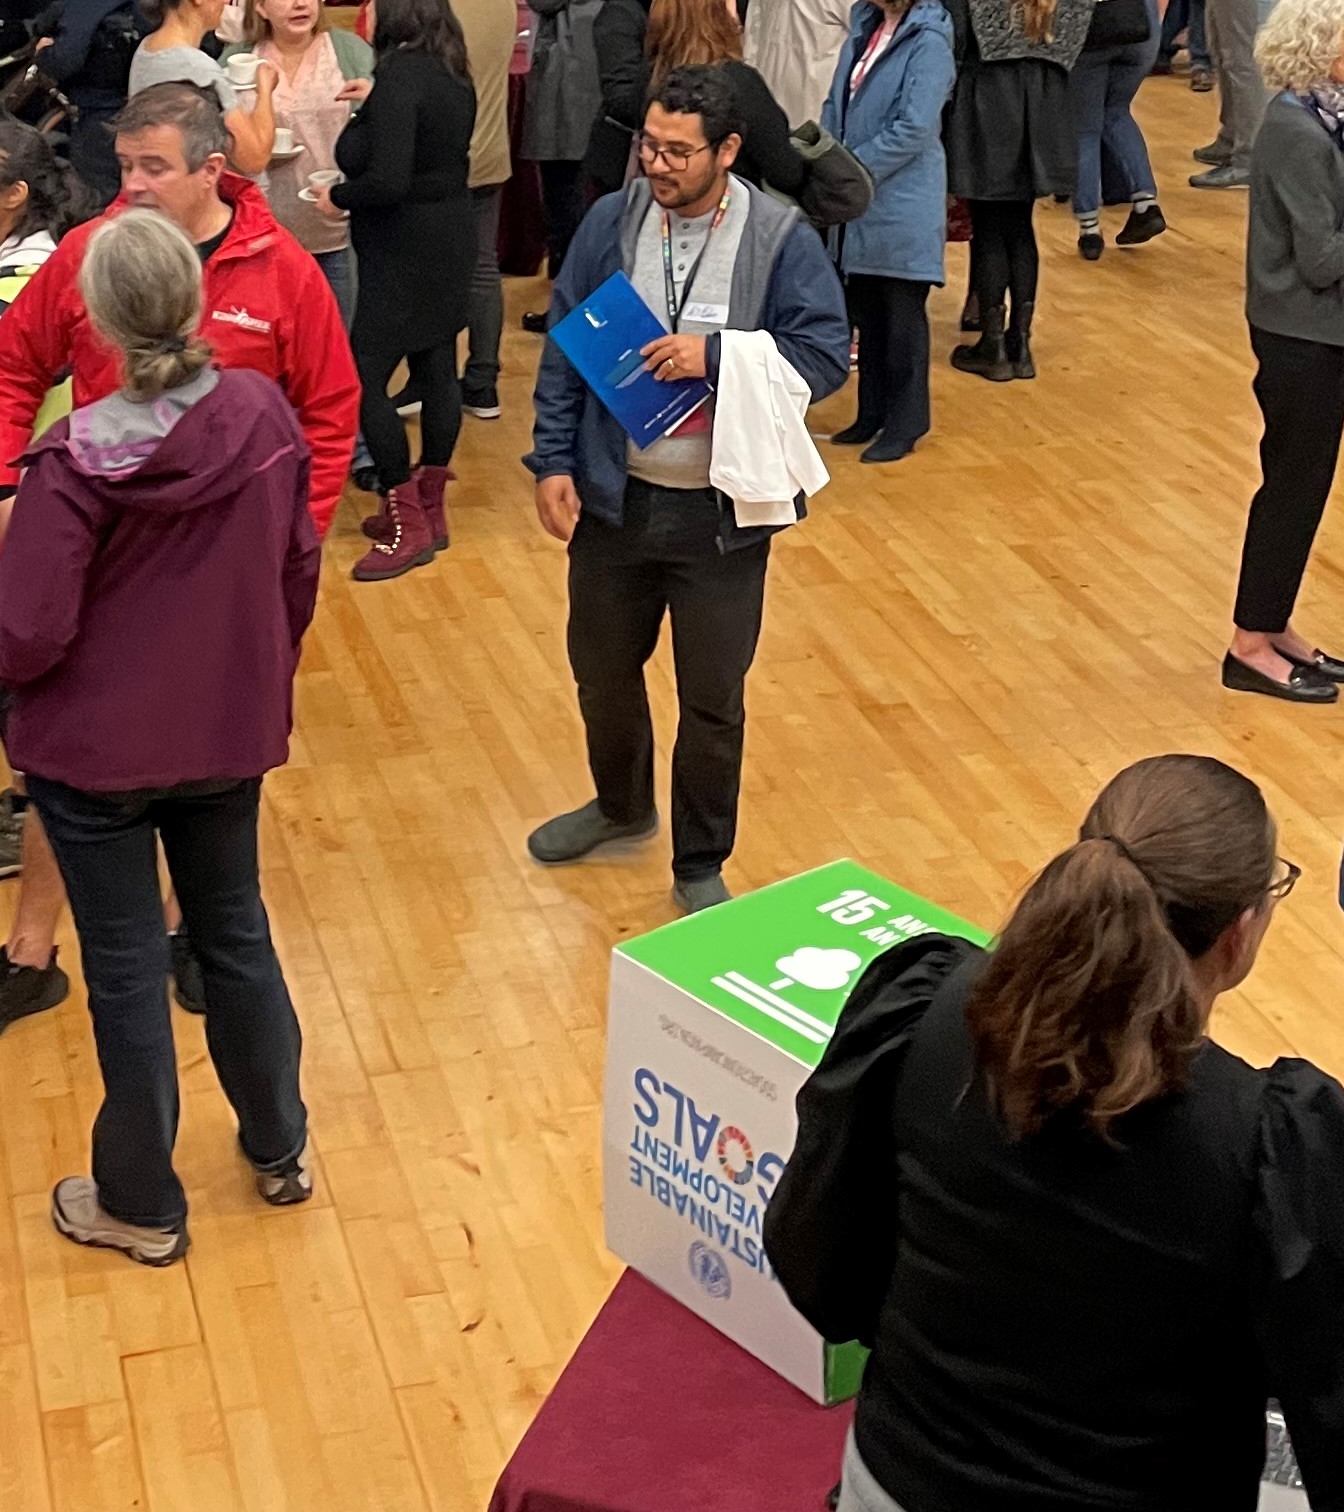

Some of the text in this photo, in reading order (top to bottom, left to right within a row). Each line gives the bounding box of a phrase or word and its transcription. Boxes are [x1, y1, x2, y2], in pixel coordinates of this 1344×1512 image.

[815, 889, 892, 925] 15
[631, 1125, 762, 1235] VELOPMENT
[633, 1067, 787, 1205] GOALS
[629, 1155, 777, 1279] USTAINABLE
